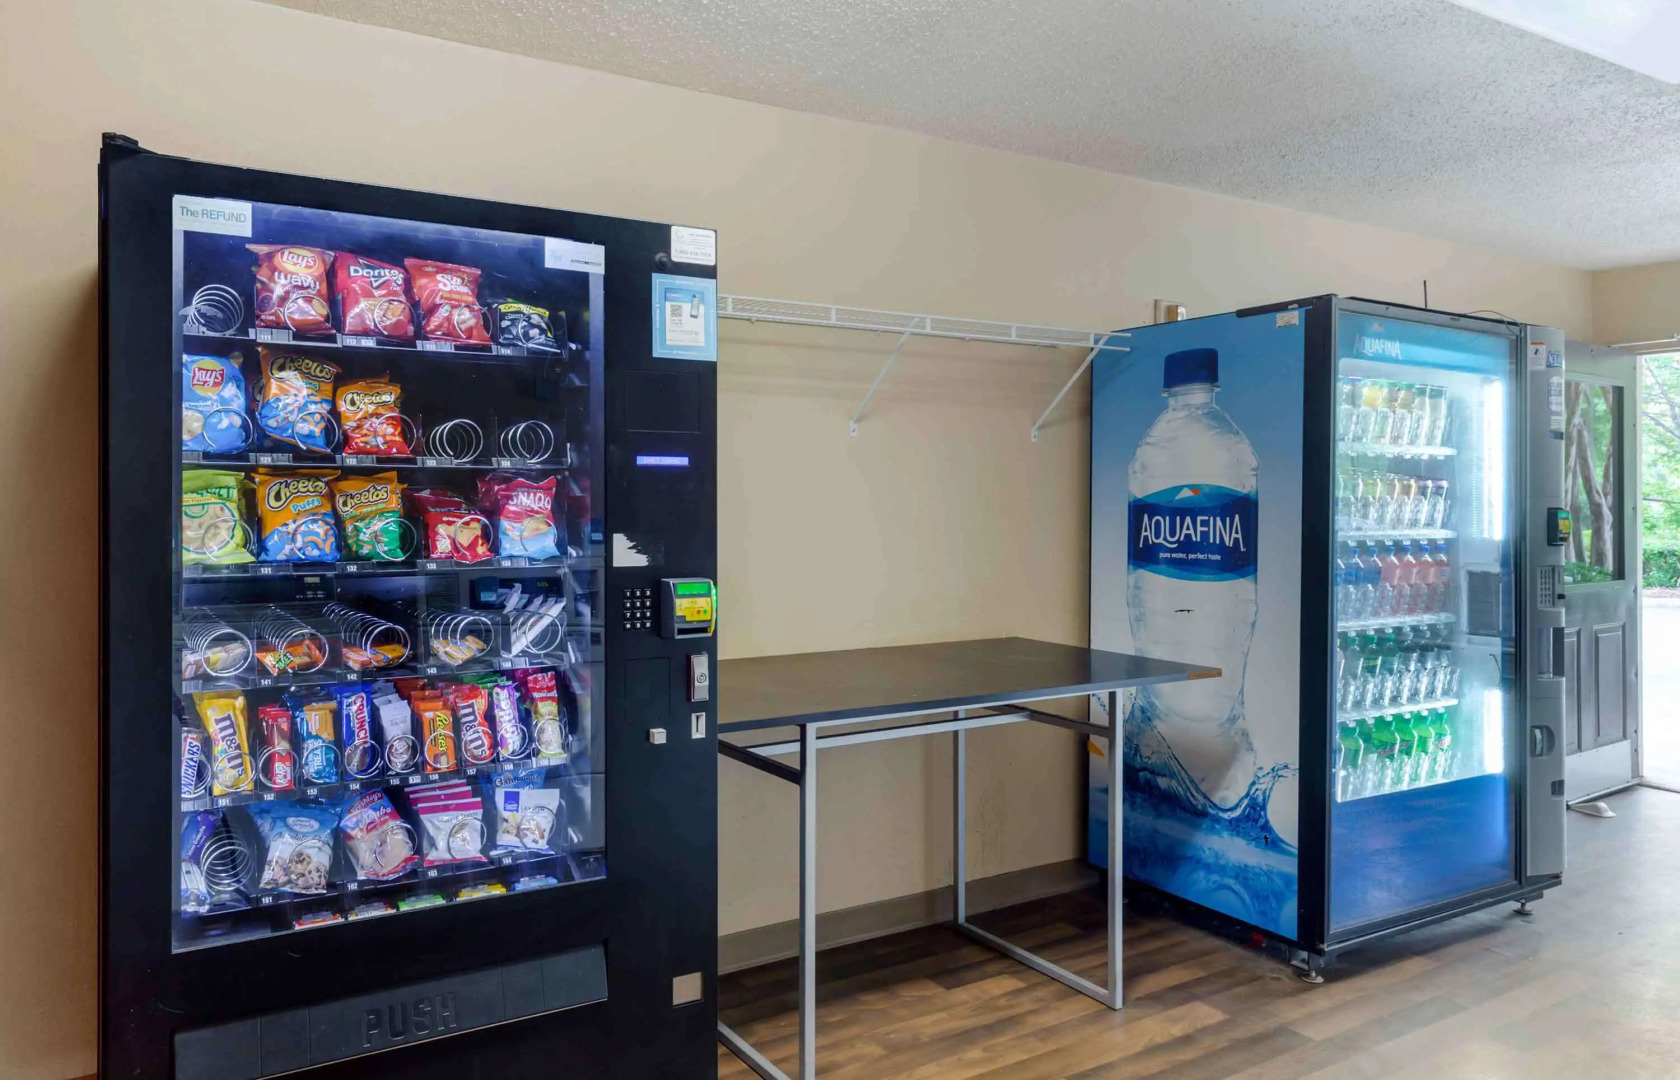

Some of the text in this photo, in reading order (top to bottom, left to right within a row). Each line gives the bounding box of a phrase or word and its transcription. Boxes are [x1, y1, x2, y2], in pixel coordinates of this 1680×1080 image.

[179, 205, 247, 223] The REFUND
[349, 264, 404, 285] Doritos
[1353, 334, 1402, 360] AQUAFINA
[290, 497, 322, 514] Puffs
[338, 485, 389, 512] Cheetos
[1139, 513, 1245, 552] AQUAFINA
[1188, 552, 1208, 561] perfect
[260, 566, 272, 574] 131
[426, 562, 437, 570] 133
[426, 667, 437, 675] 143
[390, 778, 400, 786] 155
[362, 991, 458, 1049] PUSH
